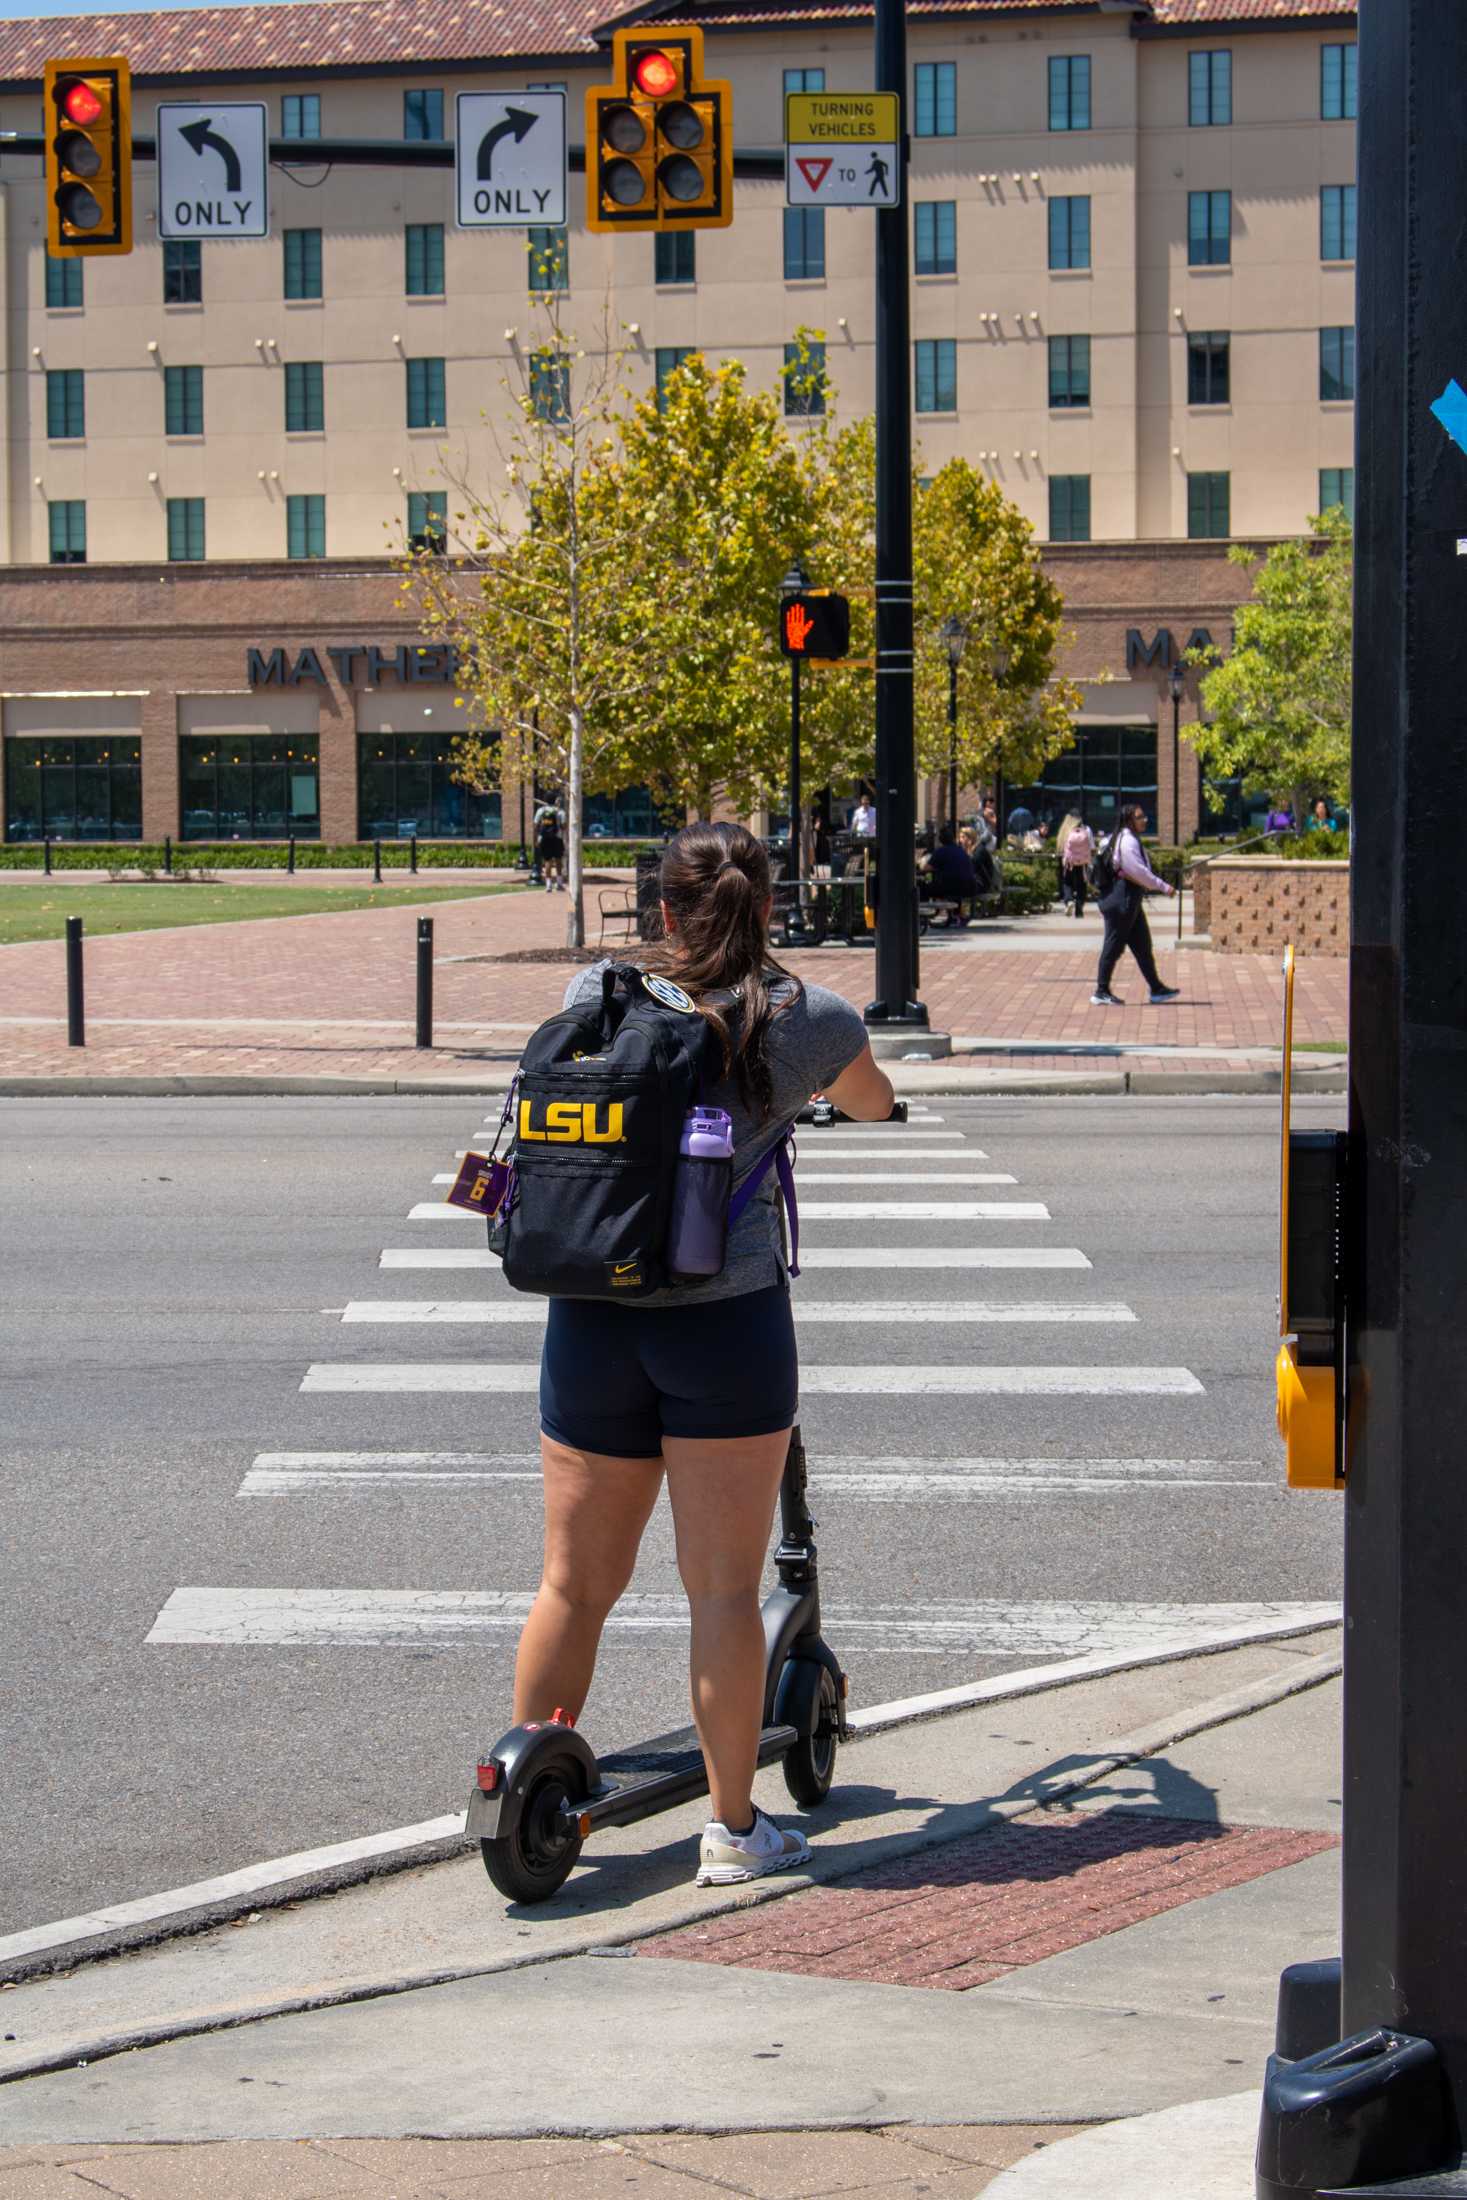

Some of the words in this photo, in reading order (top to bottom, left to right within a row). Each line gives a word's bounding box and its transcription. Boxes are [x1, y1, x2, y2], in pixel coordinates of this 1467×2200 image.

[811, 102, 874, 116] TURNING
[809, 123, 876, 136] VEHICLES
[839, 168, 856, 182] TO
[175, 201, 252, 226] ONLY
[474, 189, 552, 214] ONLY
[520, 1100, 623, 1143] LSU
[469, 1176, 490, 1201] 6
